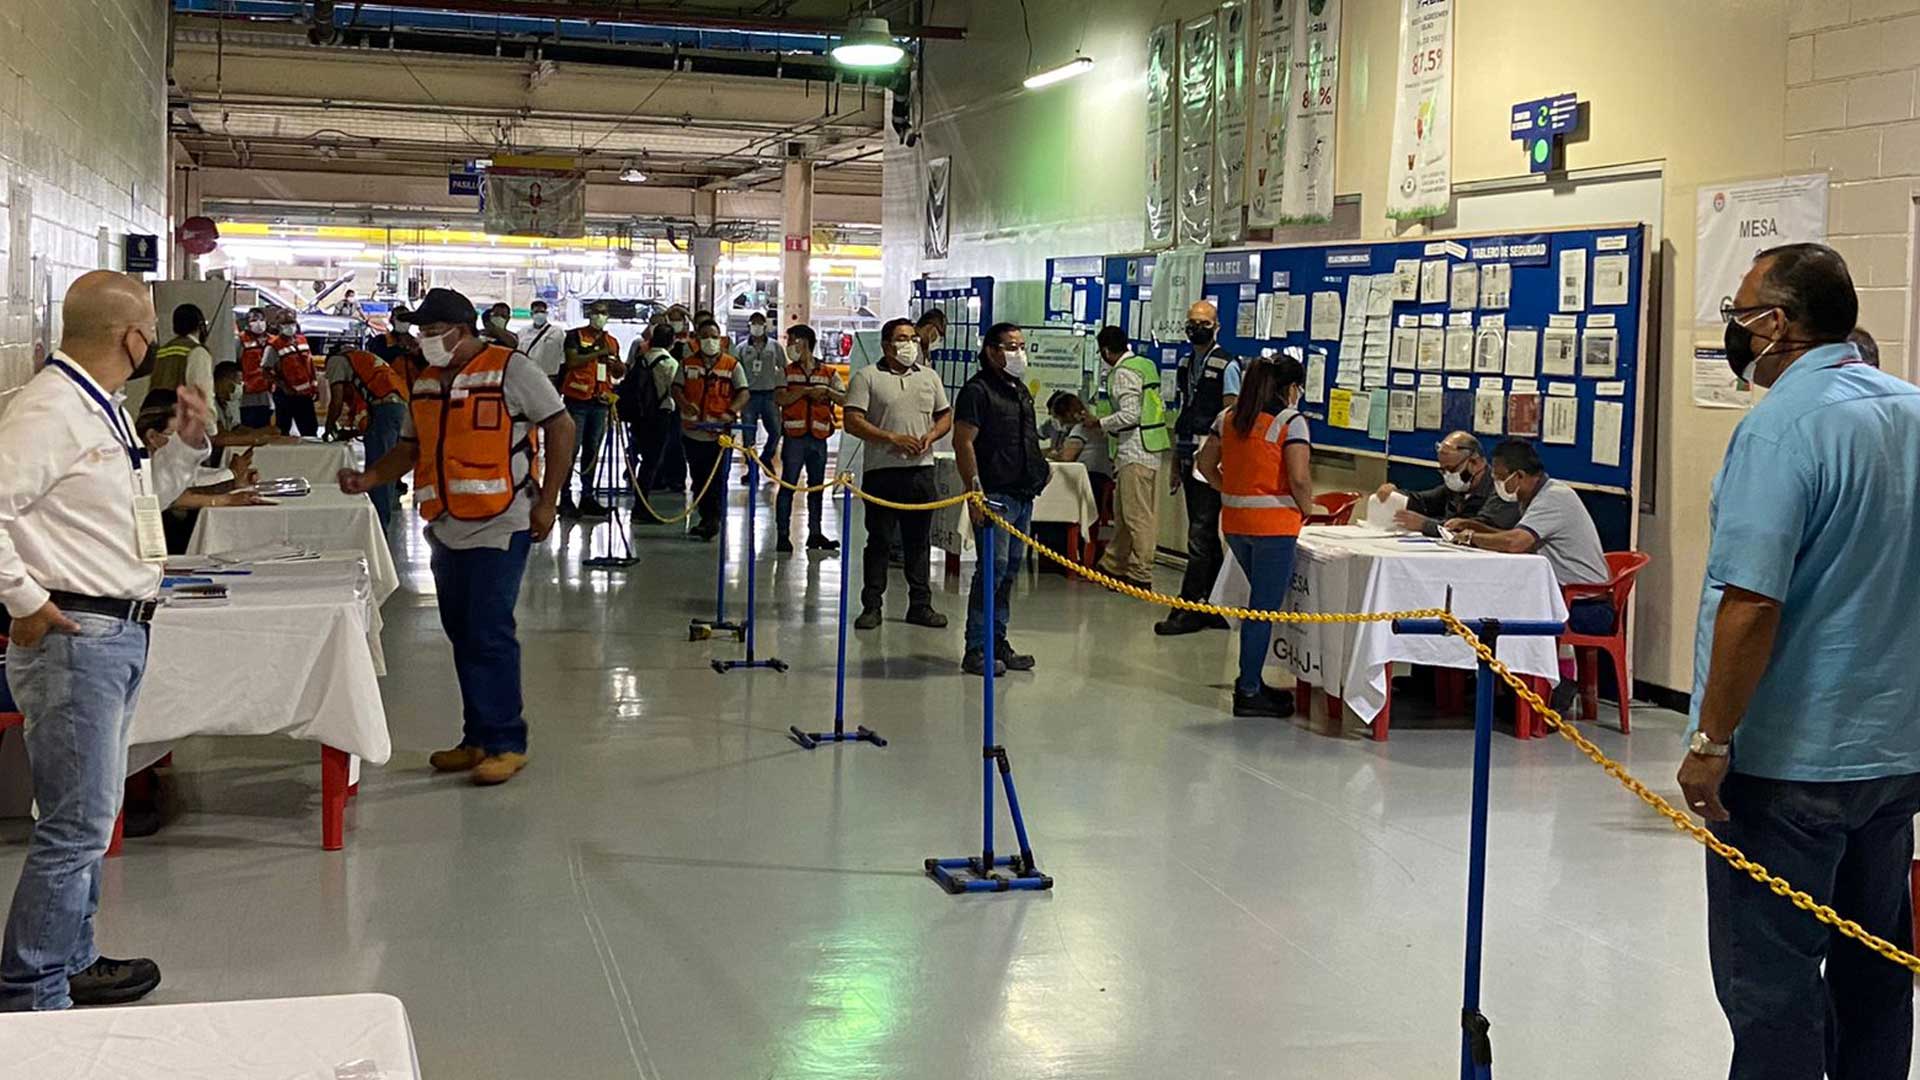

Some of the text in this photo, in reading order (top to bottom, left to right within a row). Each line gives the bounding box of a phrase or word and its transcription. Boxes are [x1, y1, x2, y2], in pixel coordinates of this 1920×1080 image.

[1740, 218, 1778, 239] MESA
[1472, 243, 1547, 259] TABLERO DE SEGURIDAD
[1290, 571, 1310, 596] ESA
